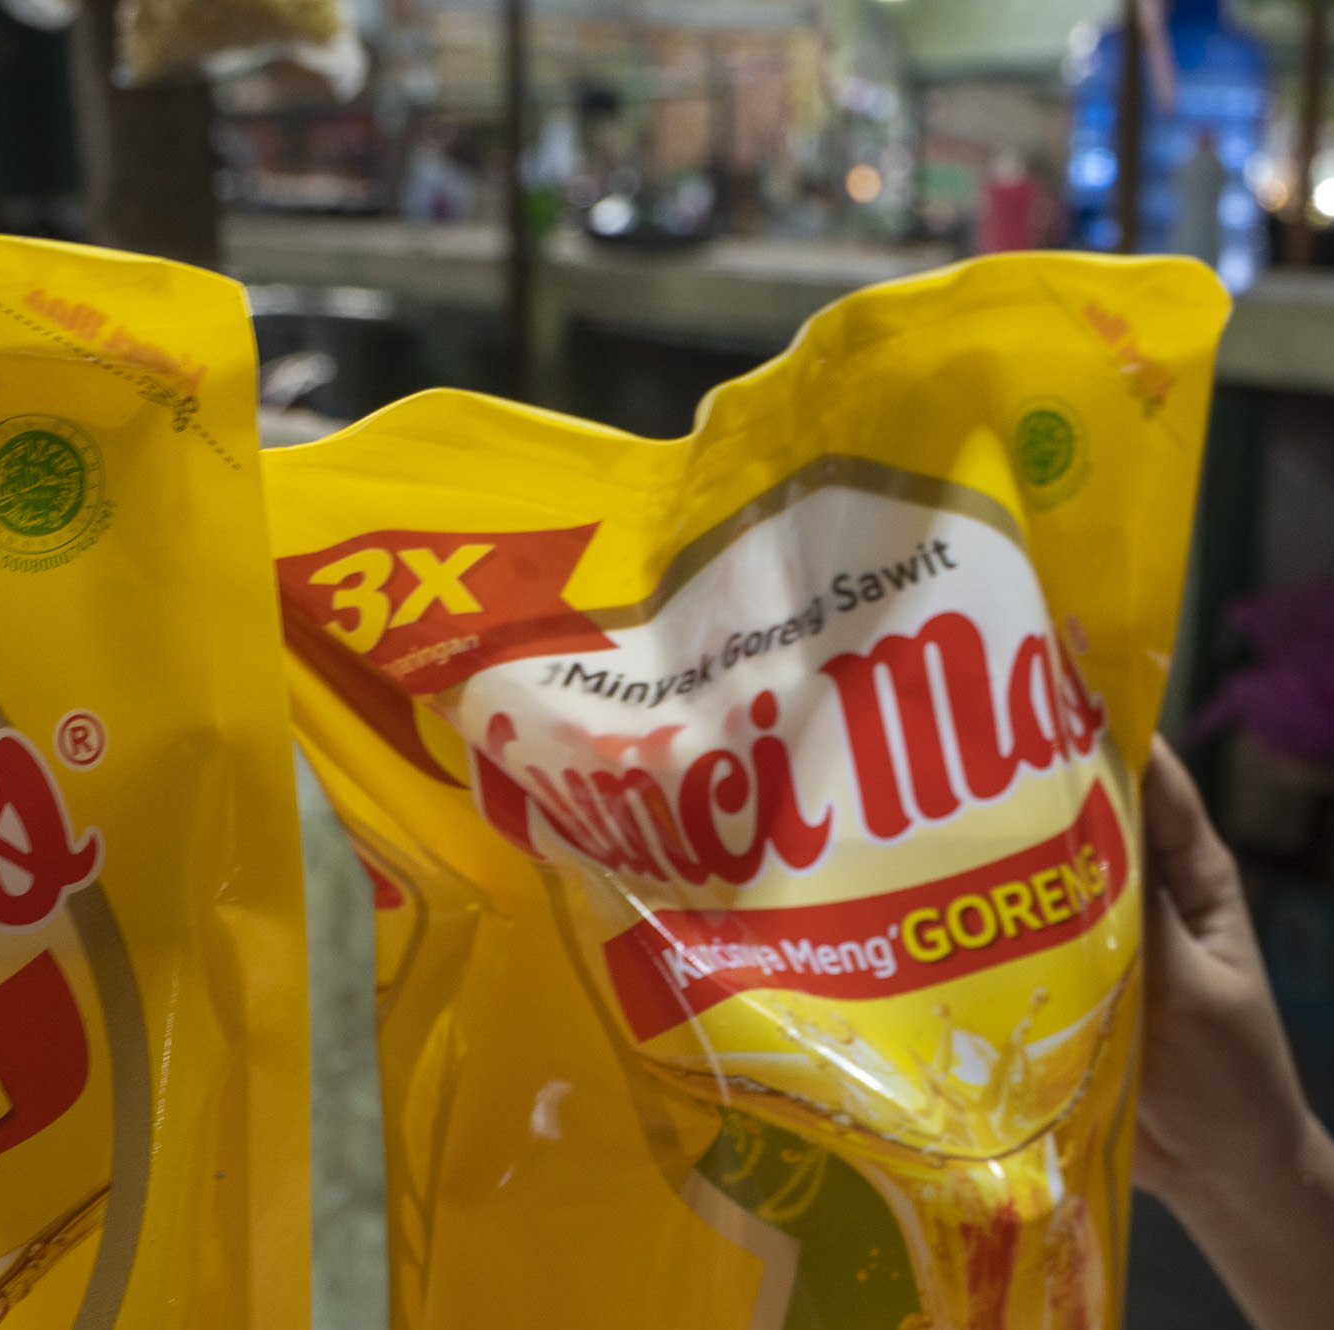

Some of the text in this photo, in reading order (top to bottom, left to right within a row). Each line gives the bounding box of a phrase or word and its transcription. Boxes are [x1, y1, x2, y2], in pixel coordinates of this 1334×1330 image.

[308, 543, 497, 655] 3X
[562, 660, 712, 709] Minyak
[830, 538, 958, 614] Sawit
[901, 843, 1108, 963] GORENG
